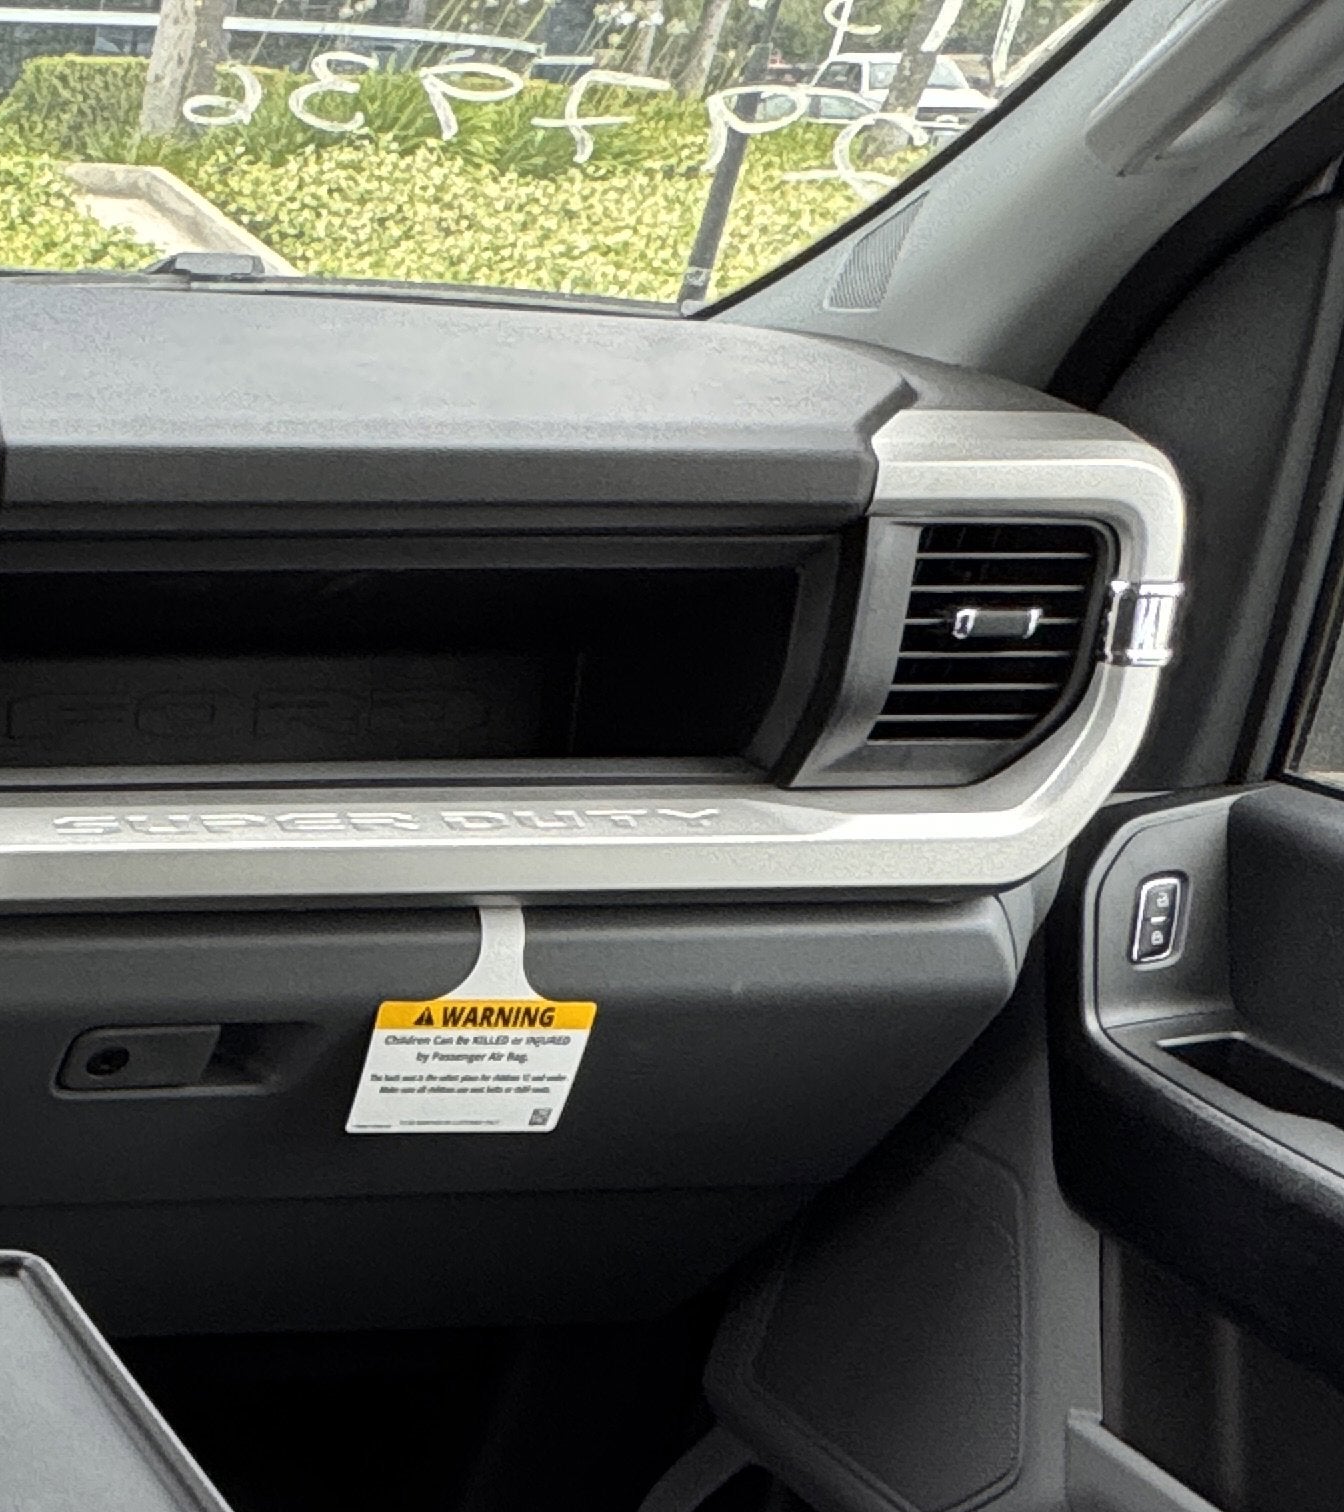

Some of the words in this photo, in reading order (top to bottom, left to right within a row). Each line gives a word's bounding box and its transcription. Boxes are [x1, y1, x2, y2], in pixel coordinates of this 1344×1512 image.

[52, 811, 420, 836] SUPER
[439, 807, 722, 832] DUTY
[440, 1006, 556, 1028] WARNING
[384, 1035, 431, 1046] Children
[433, 1035, 454, 1046] Can
[472, 1035, 510, 1046] KILLED
[511, 1036, 523, 1046] or
[525, 1035, 572, 1047] INJURED
[416, 1052, 429, 1063] by
[432, 1052, 486, 1064] Passenger
[488, 1052, 504, 1062] Air
